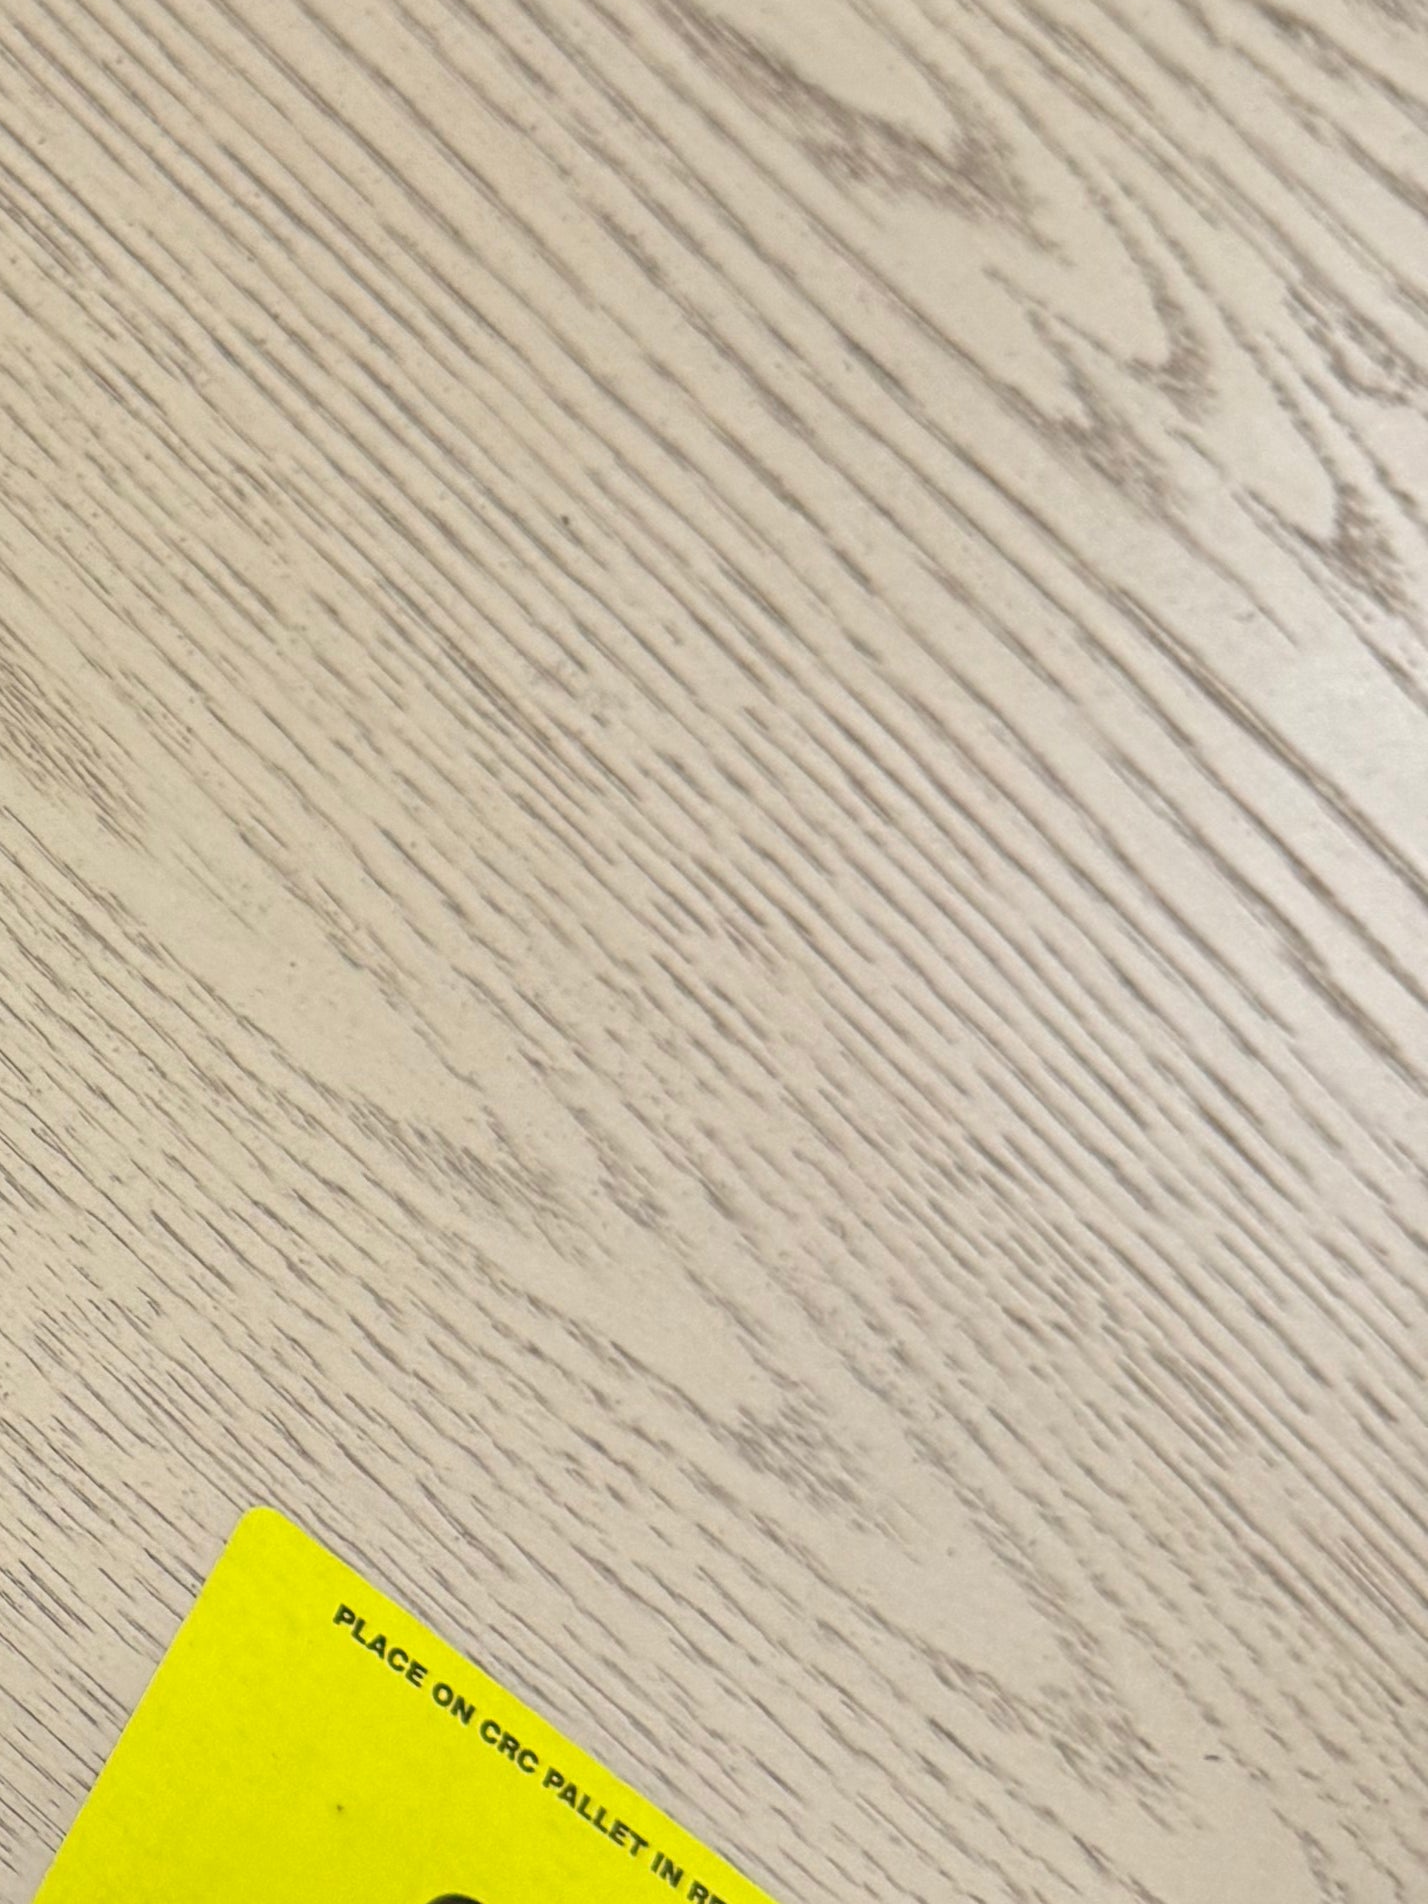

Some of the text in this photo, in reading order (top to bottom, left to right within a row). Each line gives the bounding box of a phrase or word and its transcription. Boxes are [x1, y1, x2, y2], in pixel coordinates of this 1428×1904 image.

[333, 1603, 428, 1688] PLACE
[431, 1683, 476, 1725] ON
[478, 1720, 540, 1775] CRC
[543, 1766, 649, 1859] PALLET
[651, 1850, 682, 1887] IN
